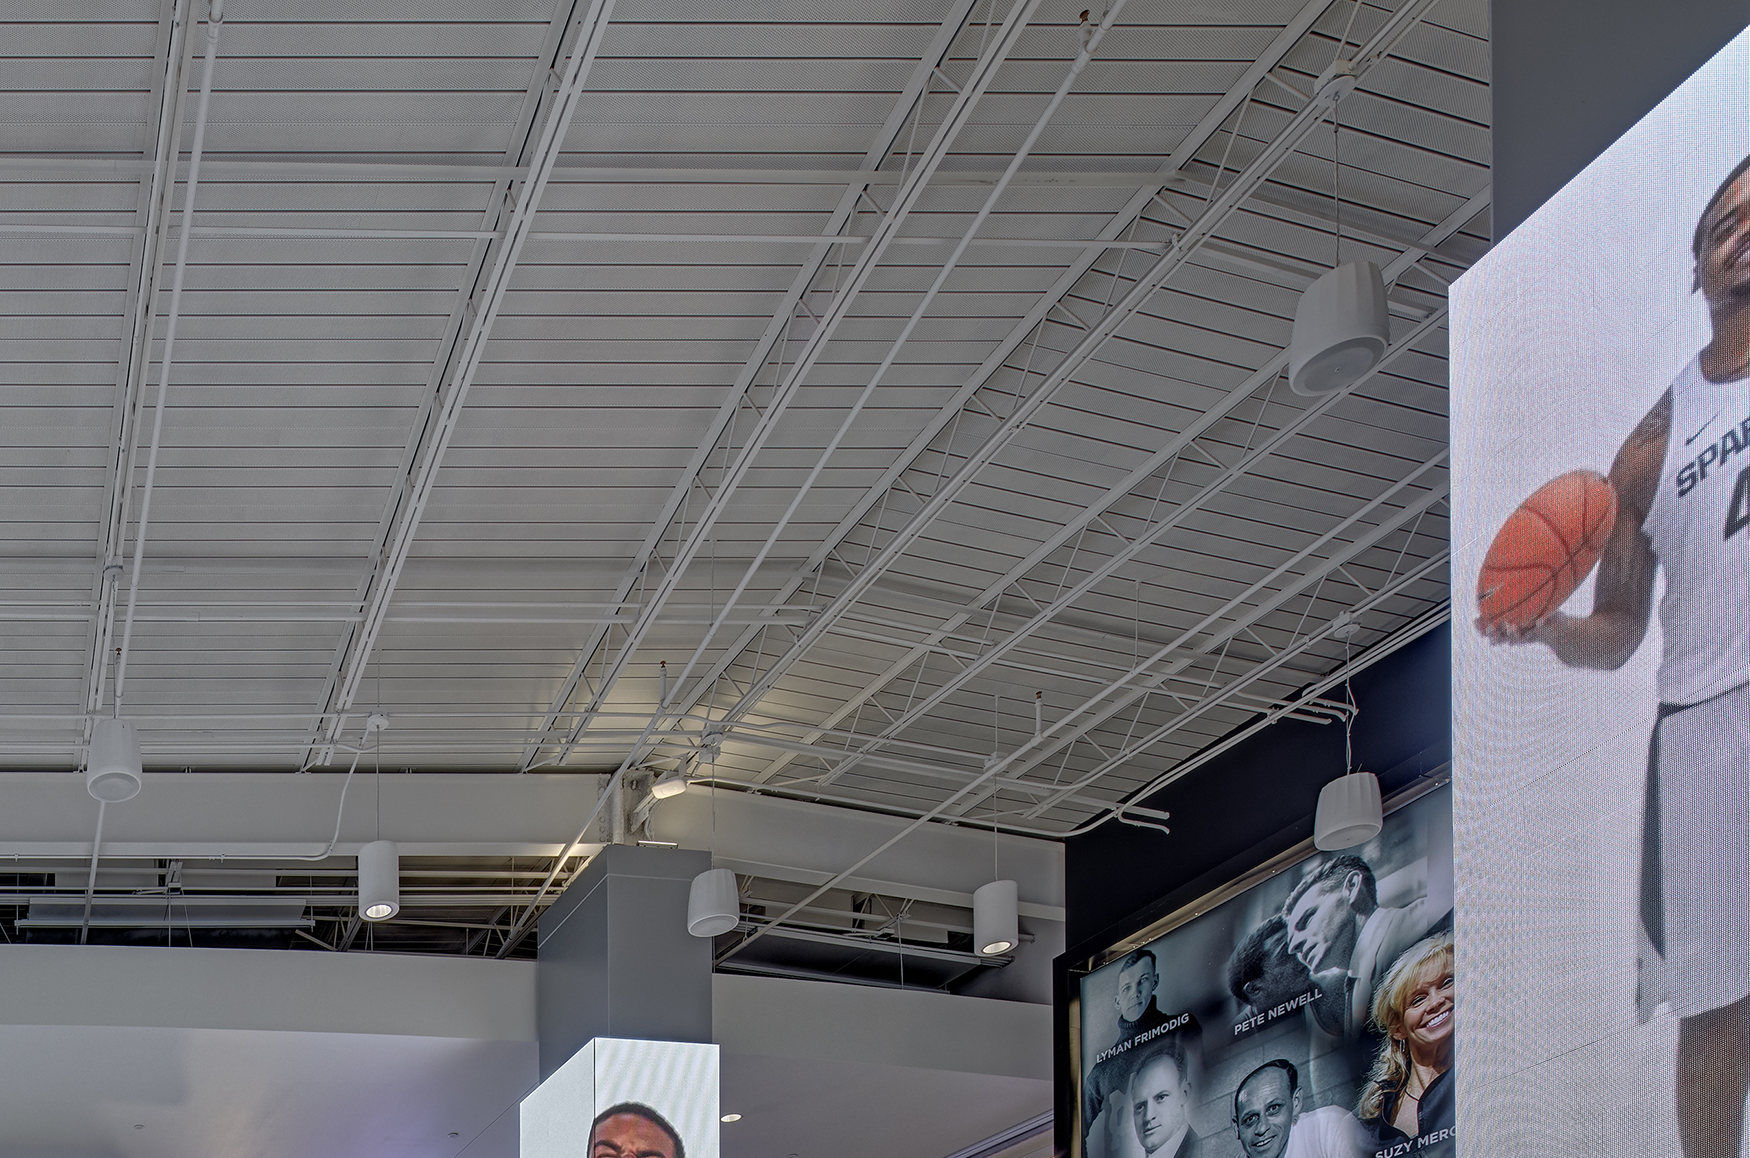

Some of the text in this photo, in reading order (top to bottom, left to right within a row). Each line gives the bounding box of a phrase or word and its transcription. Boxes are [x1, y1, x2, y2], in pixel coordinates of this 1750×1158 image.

[1234, 988, 1323, 1036] PETE NEWELL
[1096, 1012, 1190, 1064] LYMAN FRIMODIG
